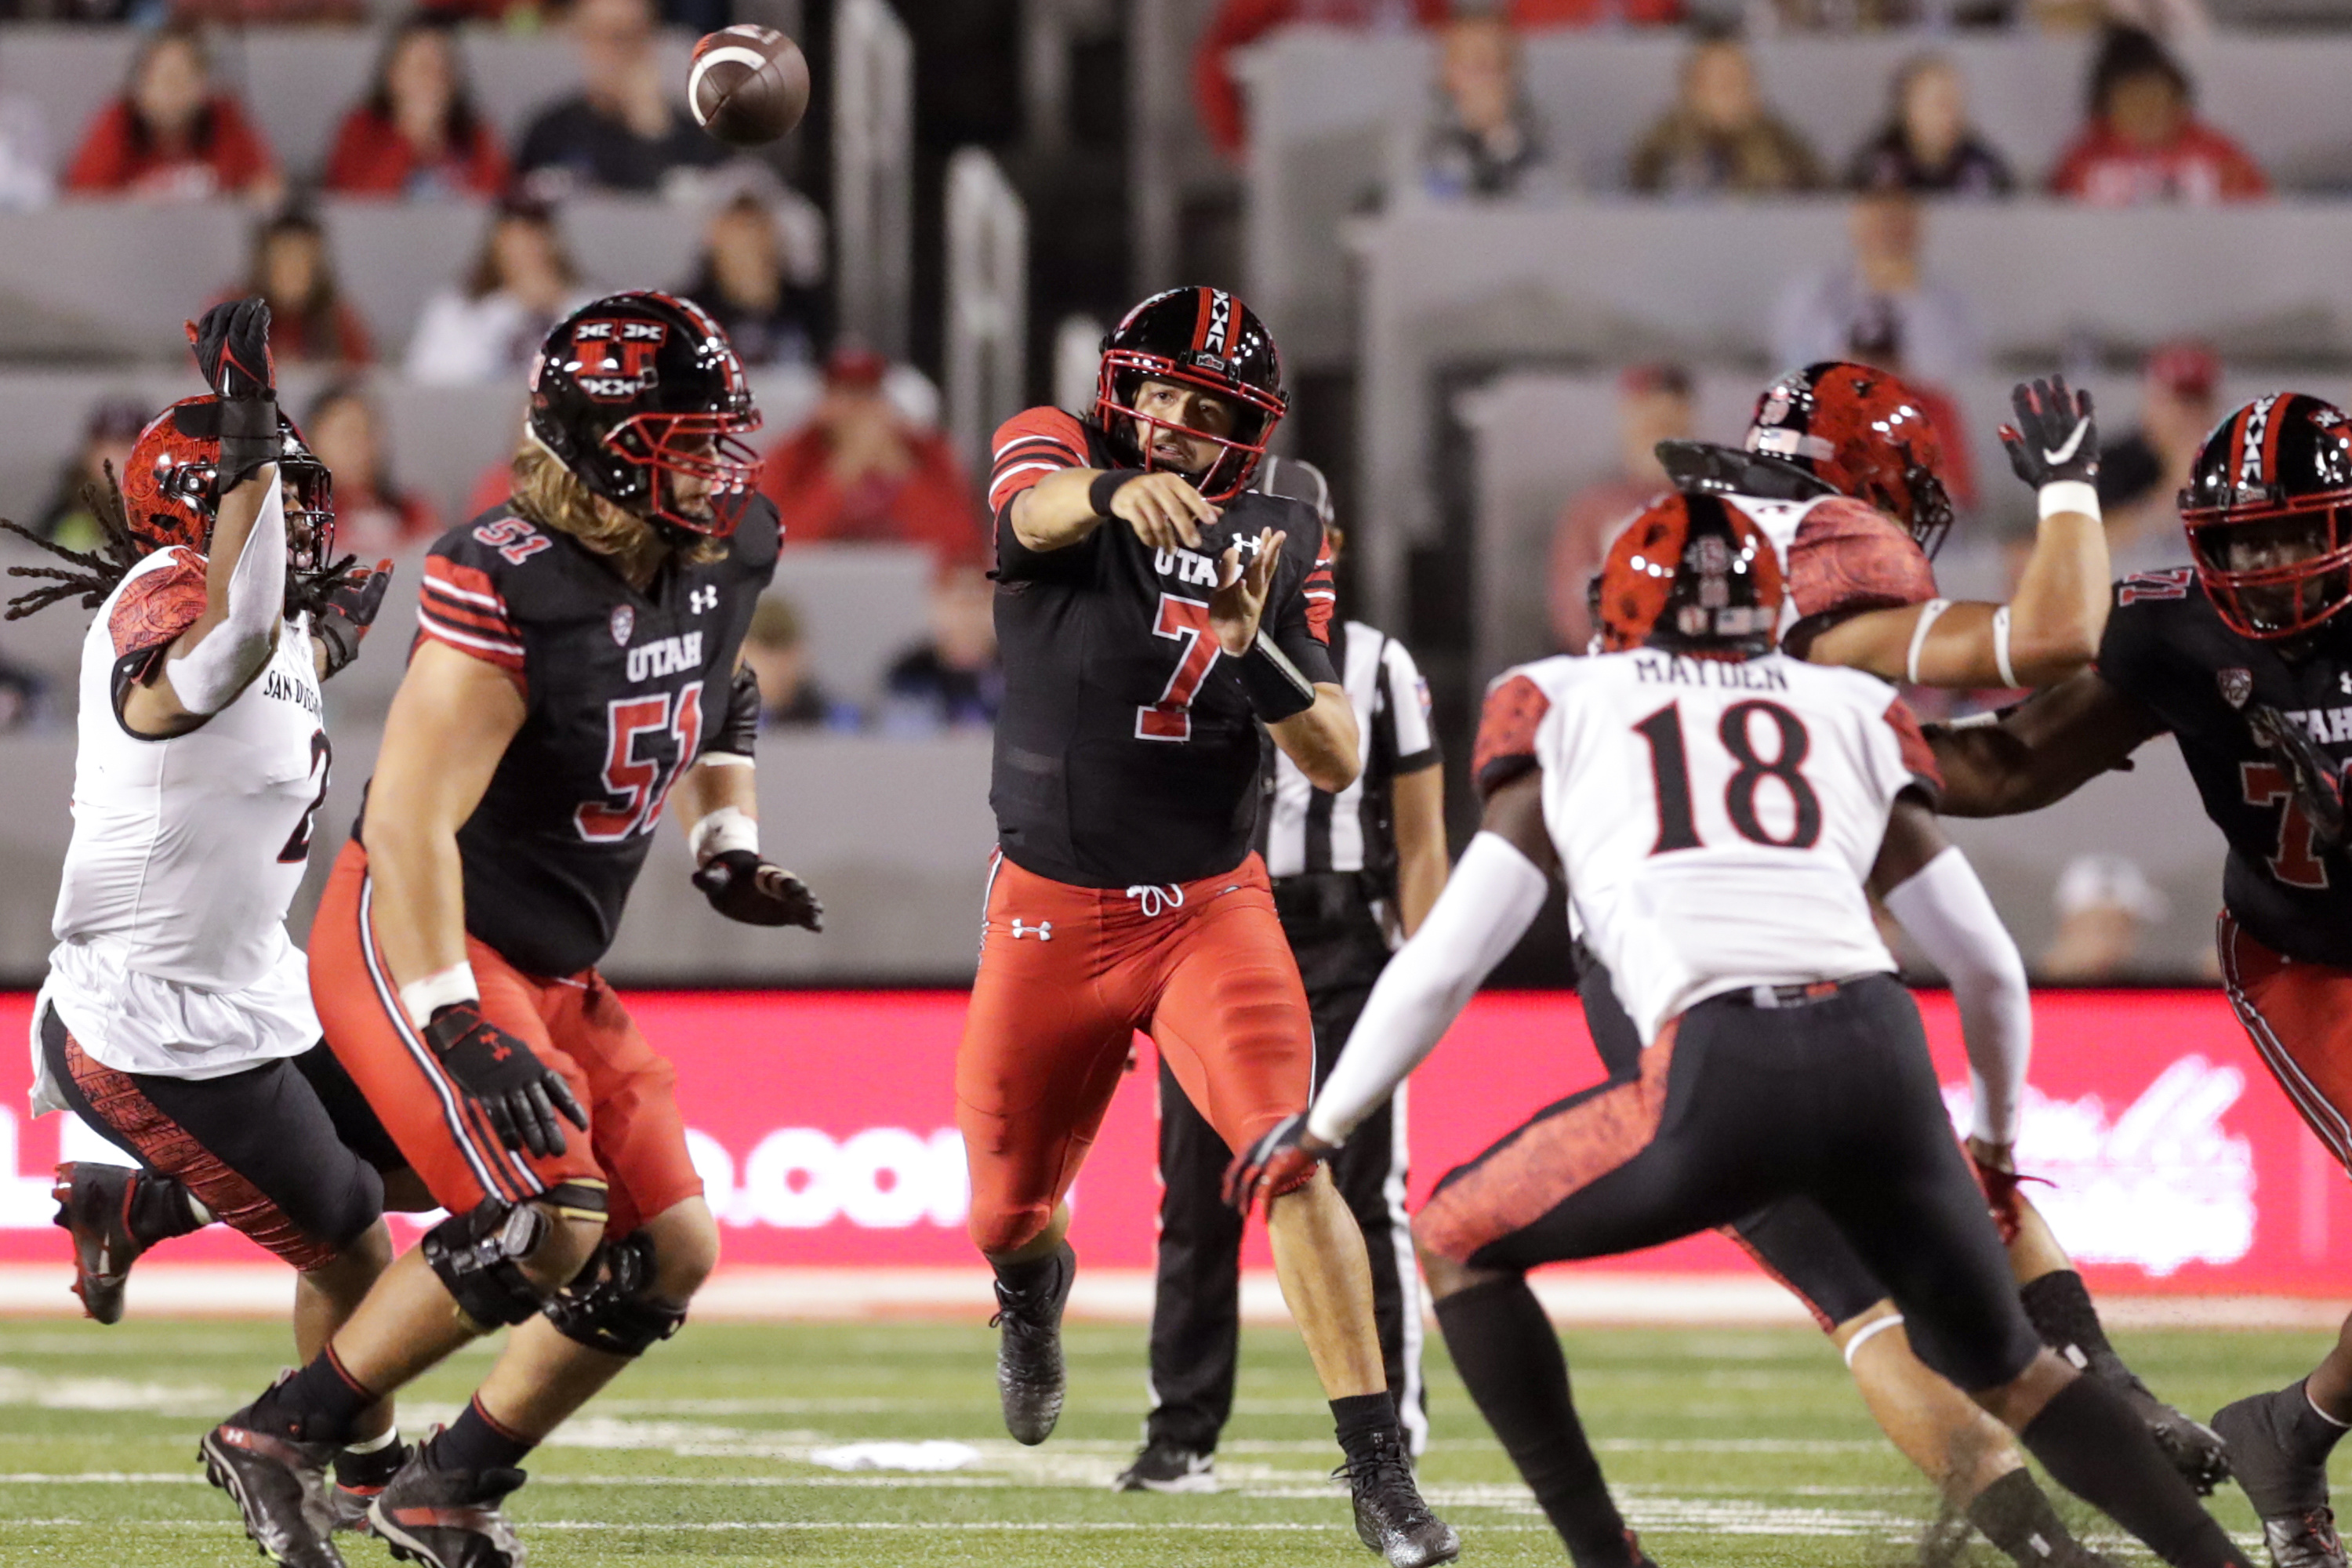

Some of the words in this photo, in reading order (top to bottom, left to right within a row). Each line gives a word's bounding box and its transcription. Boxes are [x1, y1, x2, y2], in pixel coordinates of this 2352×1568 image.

[474, 517, 552, 565] 51
[1155, 546, 1244, 587] UTA
[628, 631, 702, 682] UTAH
[1135, 591, 1222, 742] 7
[1635, 657, 1788, 691] MAYDEN
[263, 670, 292, 700] SAN
[574, 681, 703, 842] 51
[1630, 698, 1823, 859] 18
[277, 728, 332, 863] 2
